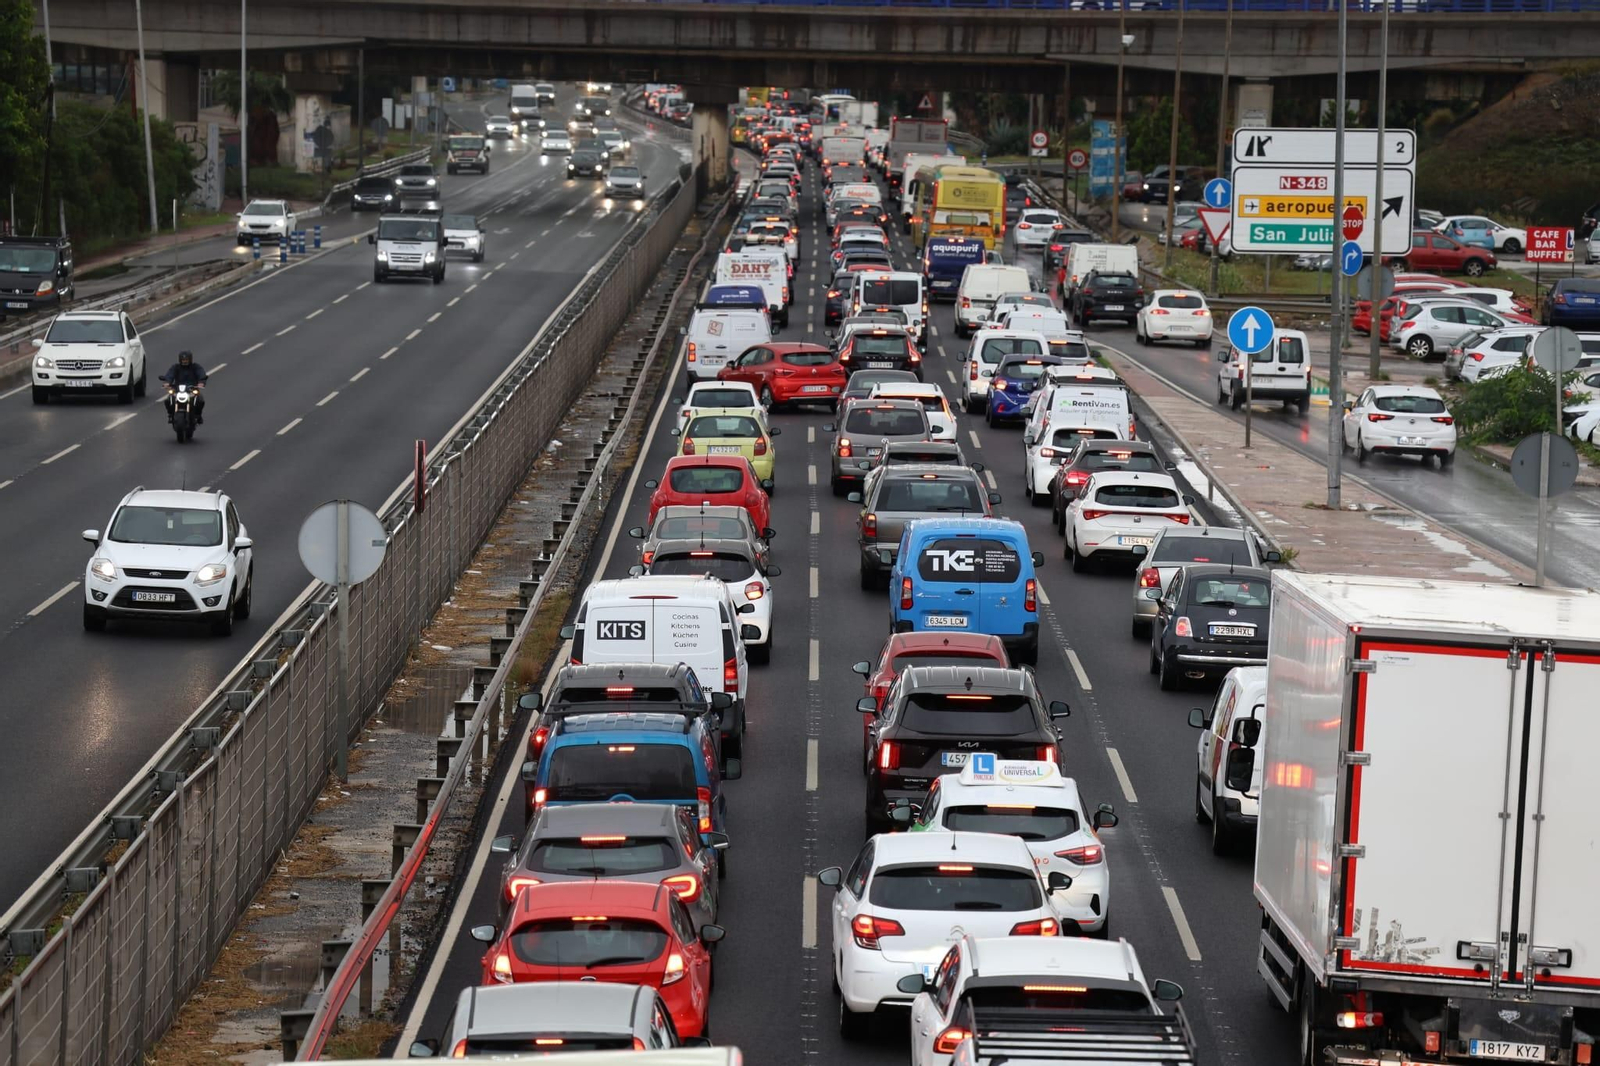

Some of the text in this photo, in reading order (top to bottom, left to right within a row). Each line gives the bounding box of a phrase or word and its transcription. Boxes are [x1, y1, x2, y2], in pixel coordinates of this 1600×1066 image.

[1396, 141, 1405, 153] 2
[1280, 177, 1327, 189] N-348
[1266, 200, 1364, 215] aeropueto
[1343, 219, 1362, 228] STOP
[1253, 227, 1336, 242] San Julia
[1533, 230, 1560, 239] CAFE
[932, 244, 979, 253] aquapurif
[1535, 240, 1556, 249] BAR
[1527, 250, 1563, 259] BUFFET
[731, 263, 771, 274] DANY
[1072, 400, 1120, 408] RentiVan.es
[926, 550, 975, 571] TKE
[929, 617, 948, 625] 6345
[600, 622, 642, 638] KITS
[1215, 627, 1252, 636] 2298 HXL
[949, 754, 970, 763] 457
[977, 757, 990, 772] L
[1482, 1042, 1539, 1058] 1817 KYZ
